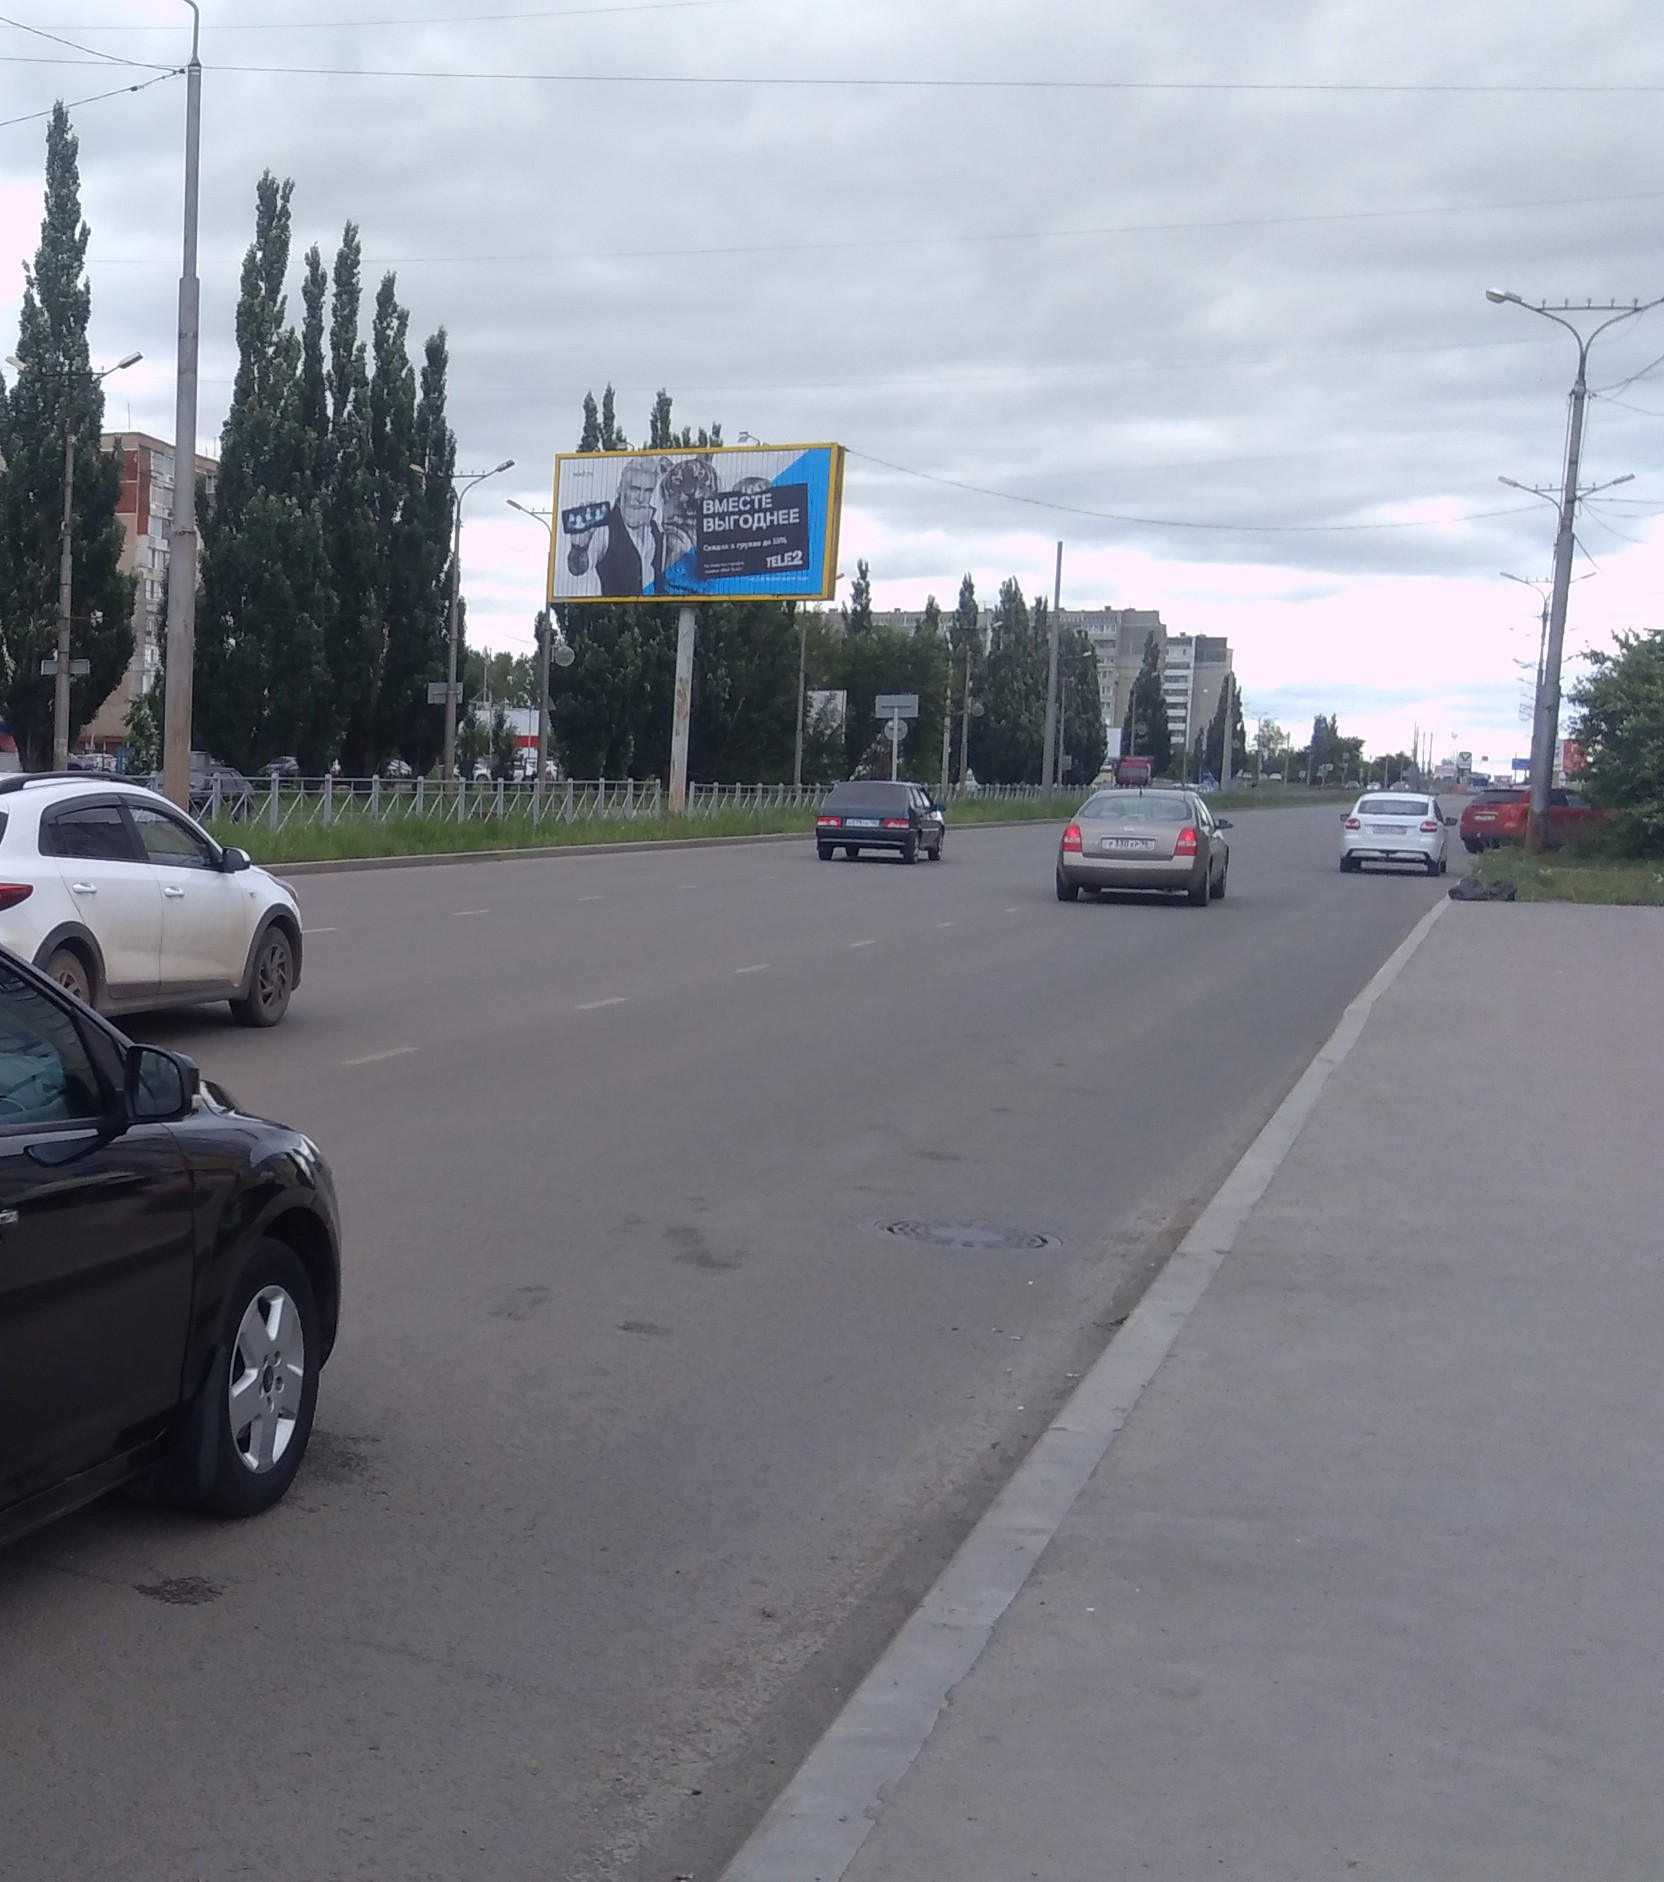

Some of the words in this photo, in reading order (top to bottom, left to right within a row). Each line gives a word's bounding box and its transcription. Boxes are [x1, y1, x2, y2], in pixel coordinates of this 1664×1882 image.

[702, 493, 773, 515] ВМЕСТЕ
[703, 508, 800, 532] ВЫГОДНЕЕ
[766, 550, 803, 568] TELE2
